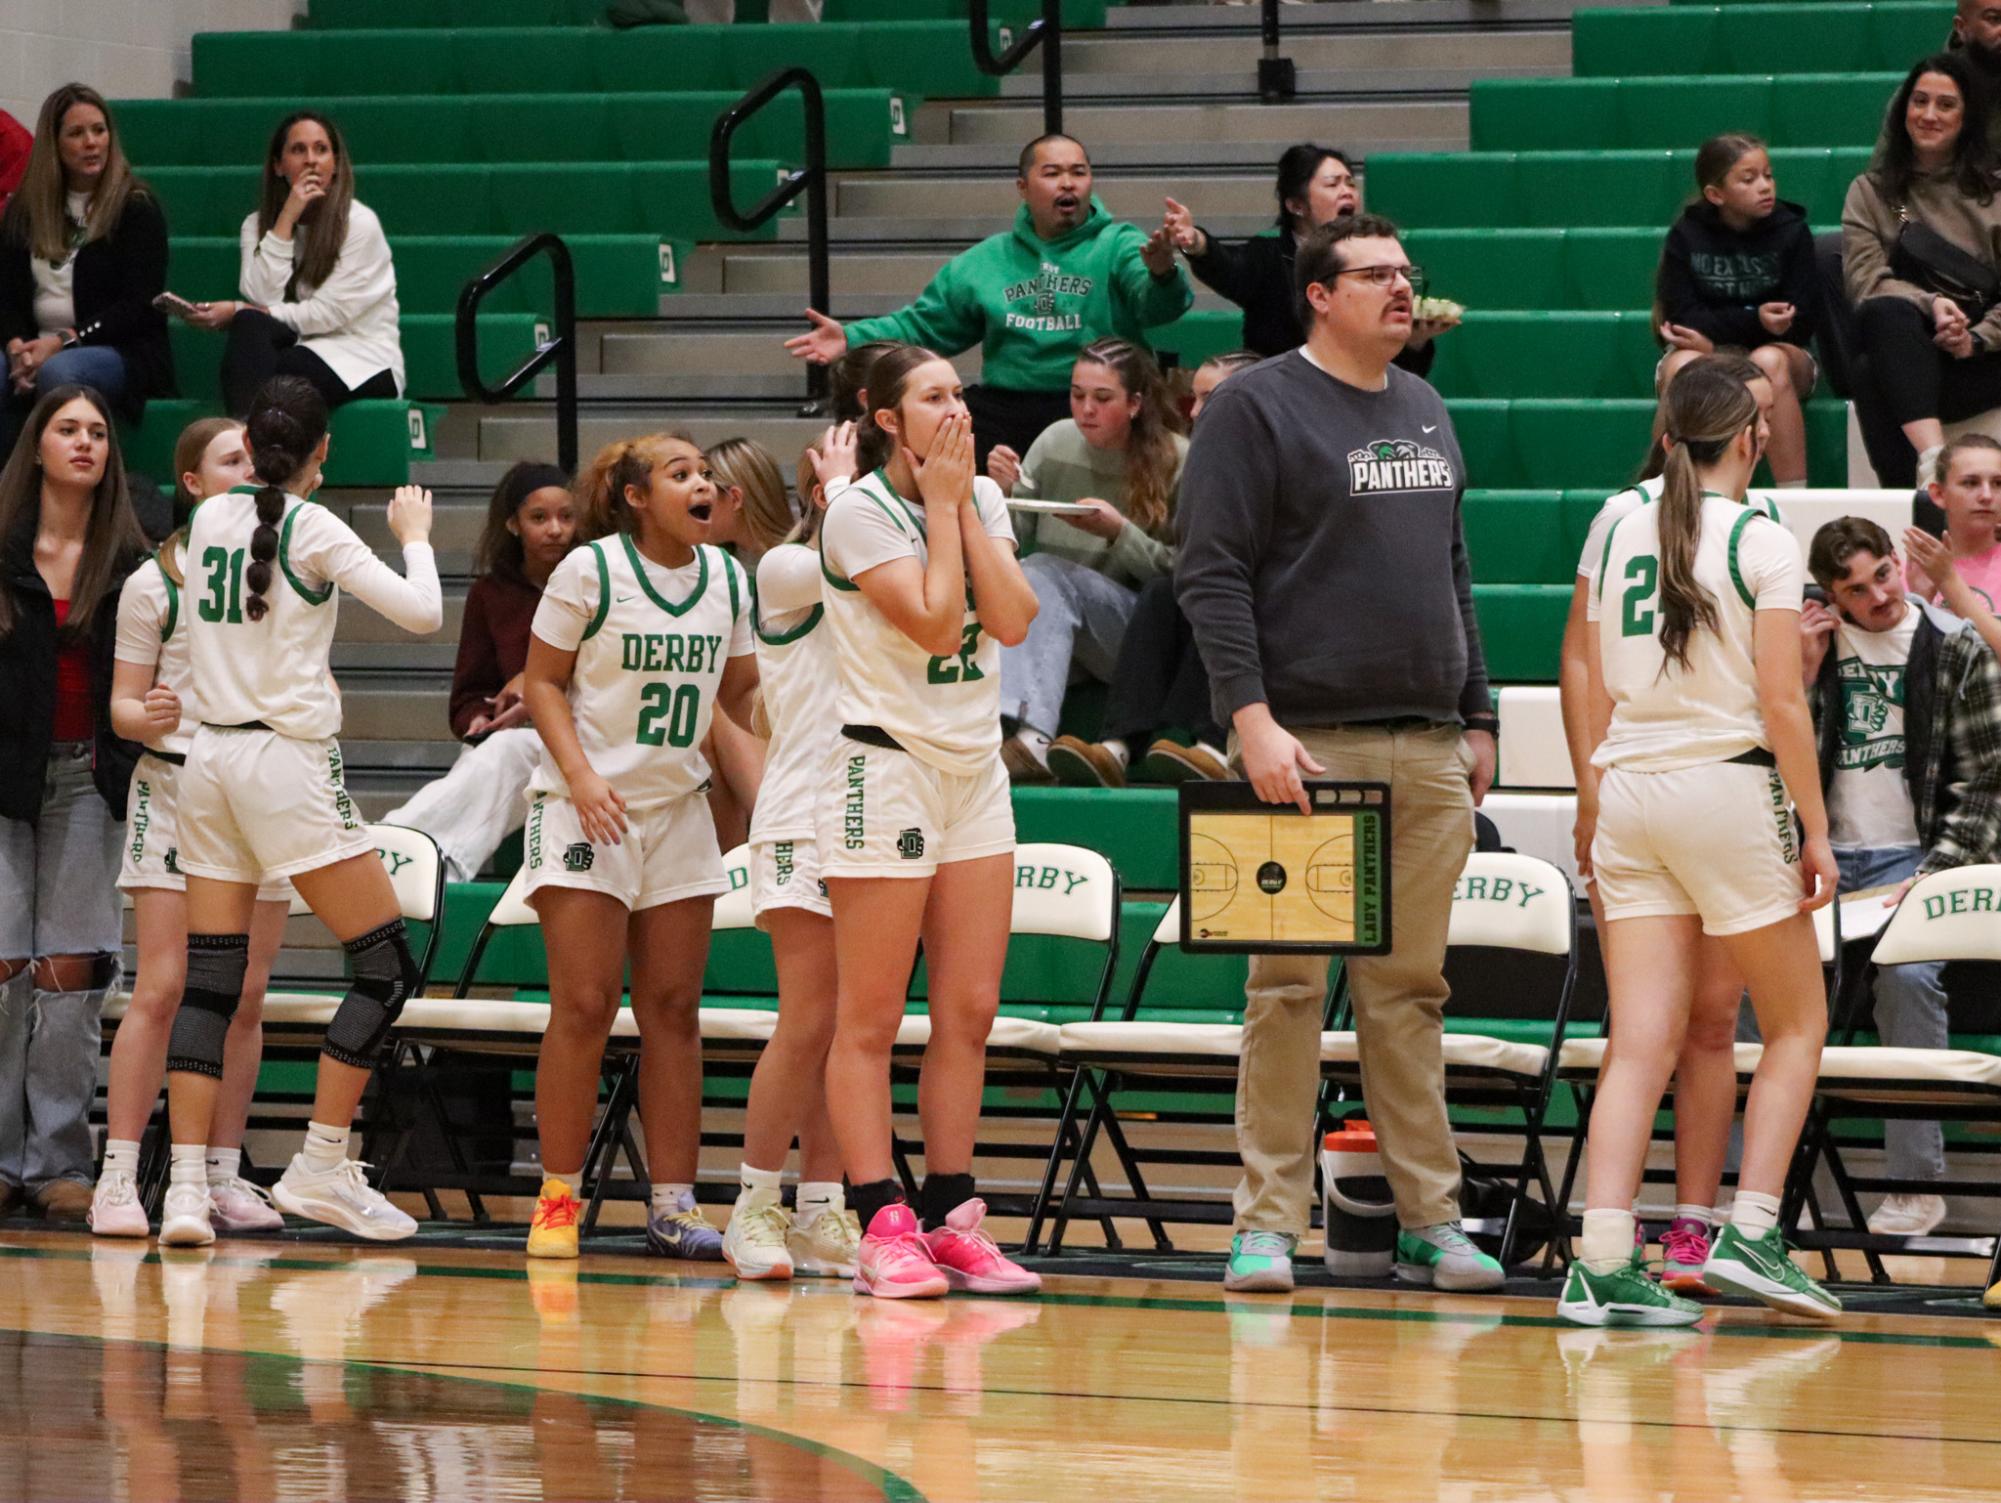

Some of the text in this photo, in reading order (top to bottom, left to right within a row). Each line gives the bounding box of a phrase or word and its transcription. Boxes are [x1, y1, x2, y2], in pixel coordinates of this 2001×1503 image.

[1005, 312, 1082, 332] FOOTBALL
[1352, 459, 1454, 492] PANTHERS
[198, 546, 245, 625] 31
[1622, 555, 1665, 637] 2
[622, 633, 722, 673] DERBY
[636, 682, 700, 748] 20
[1839, 740, 1905, 766] ANTHERS
[845, 755, 866, 850] PANTHERS
[529, 801, 543, 870] NTHERS
[775, 840, 794, 886] HERS
[1015, 865, 1089, 895] RBY
[1363, 815, 1377, 942] LADY PANTHERS
[1453, 877, 1545, 908] RBY
